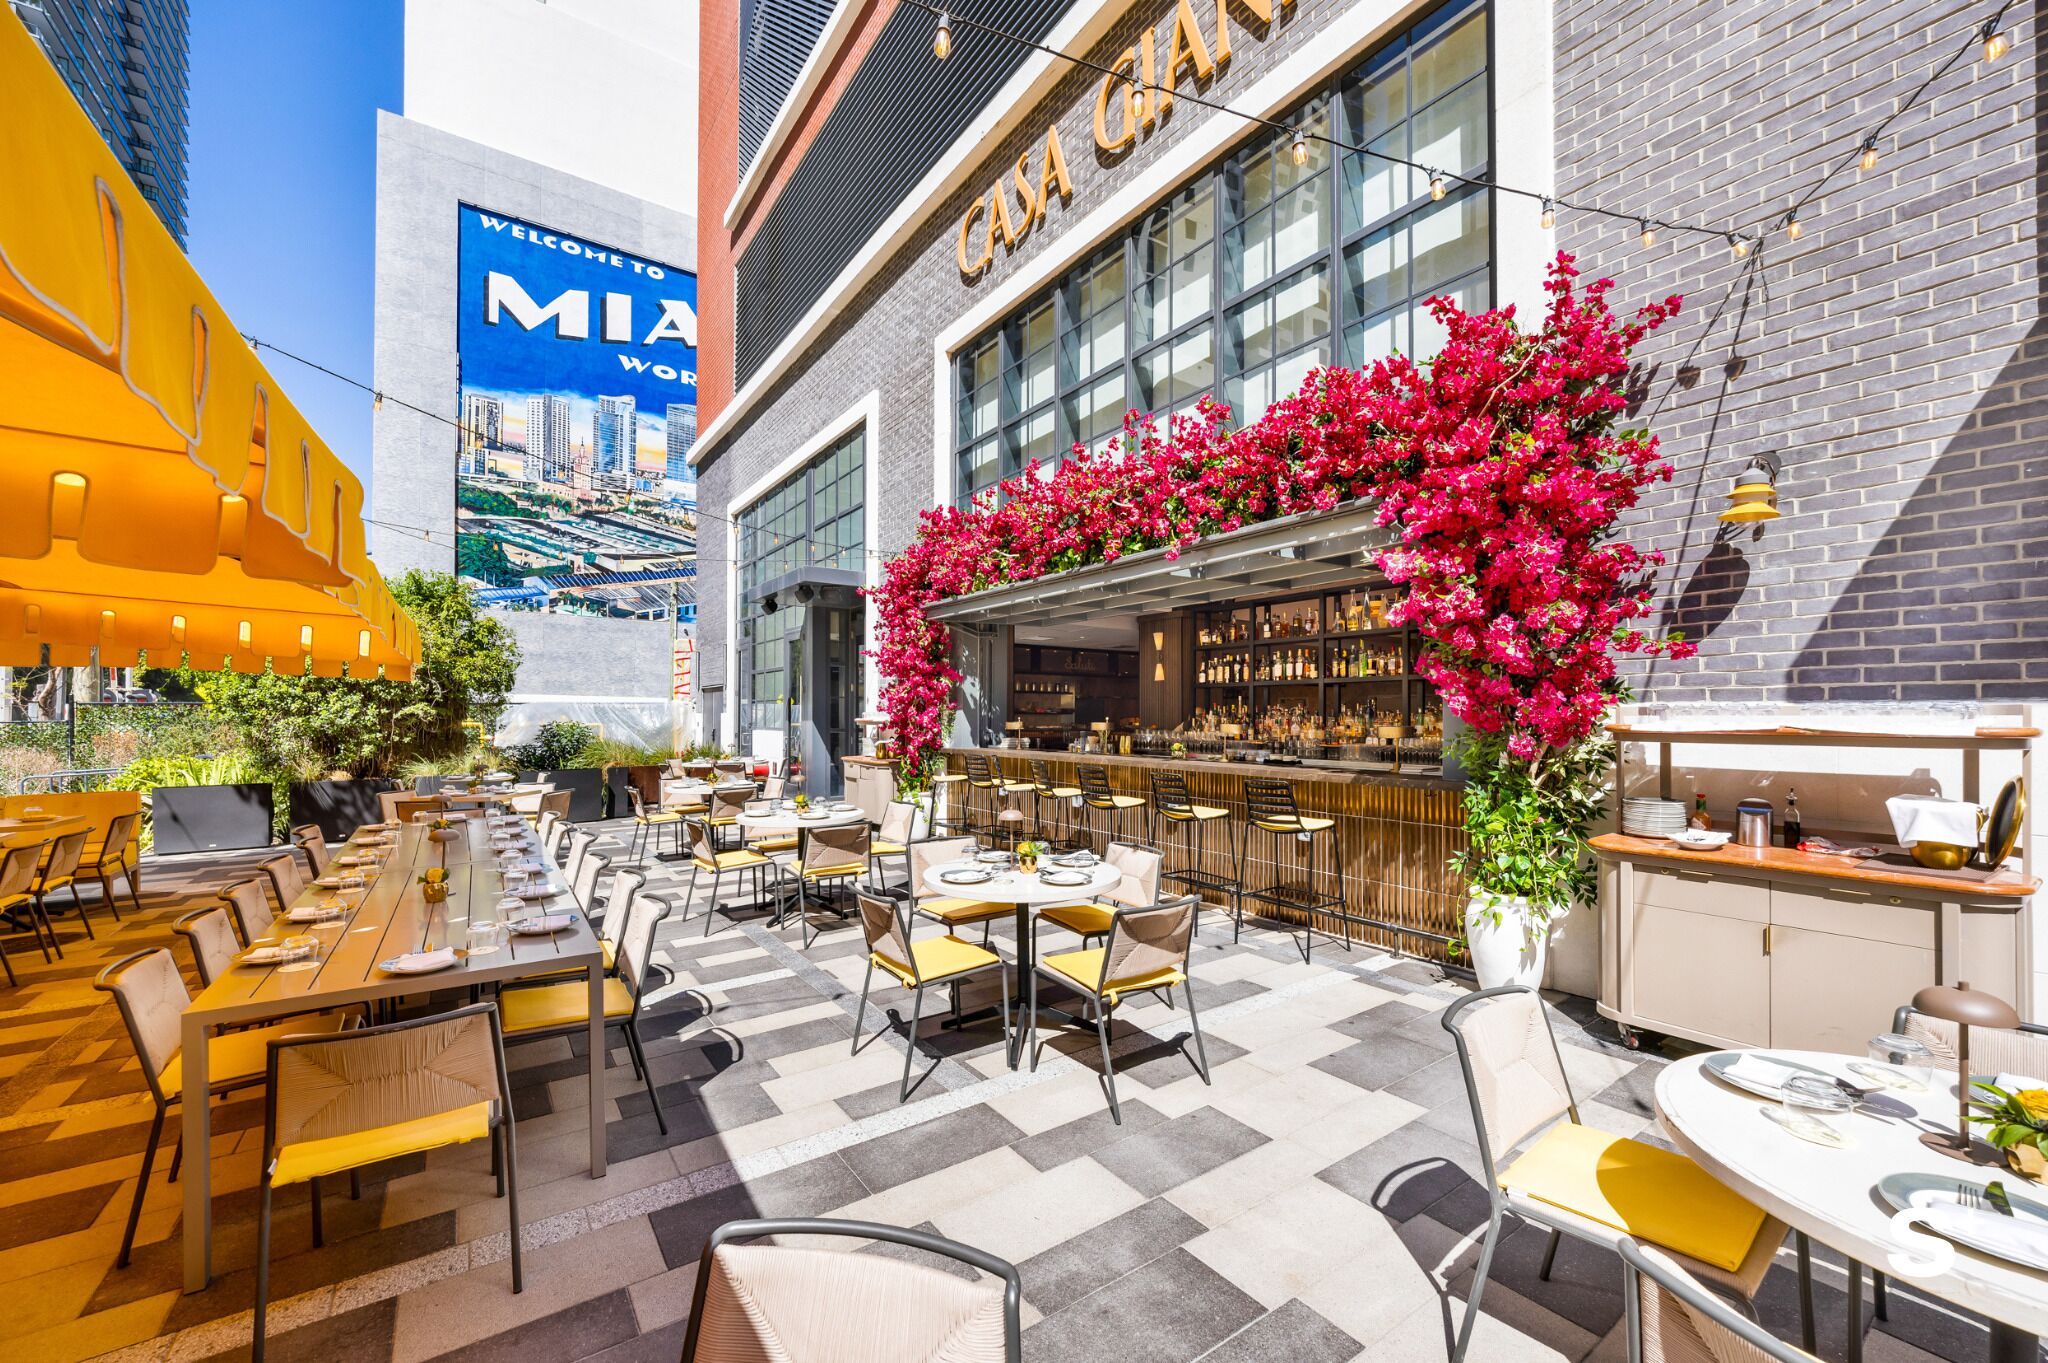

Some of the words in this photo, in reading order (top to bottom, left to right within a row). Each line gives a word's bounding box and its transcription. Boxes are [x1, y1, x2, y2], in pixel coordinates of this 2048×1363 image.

[958, 125, 1072, 273] CASA
[480, 214, 623, 268] WELCOME
[631, 261, 665, 280] TO
[485, 270, 697, 348] MIA
